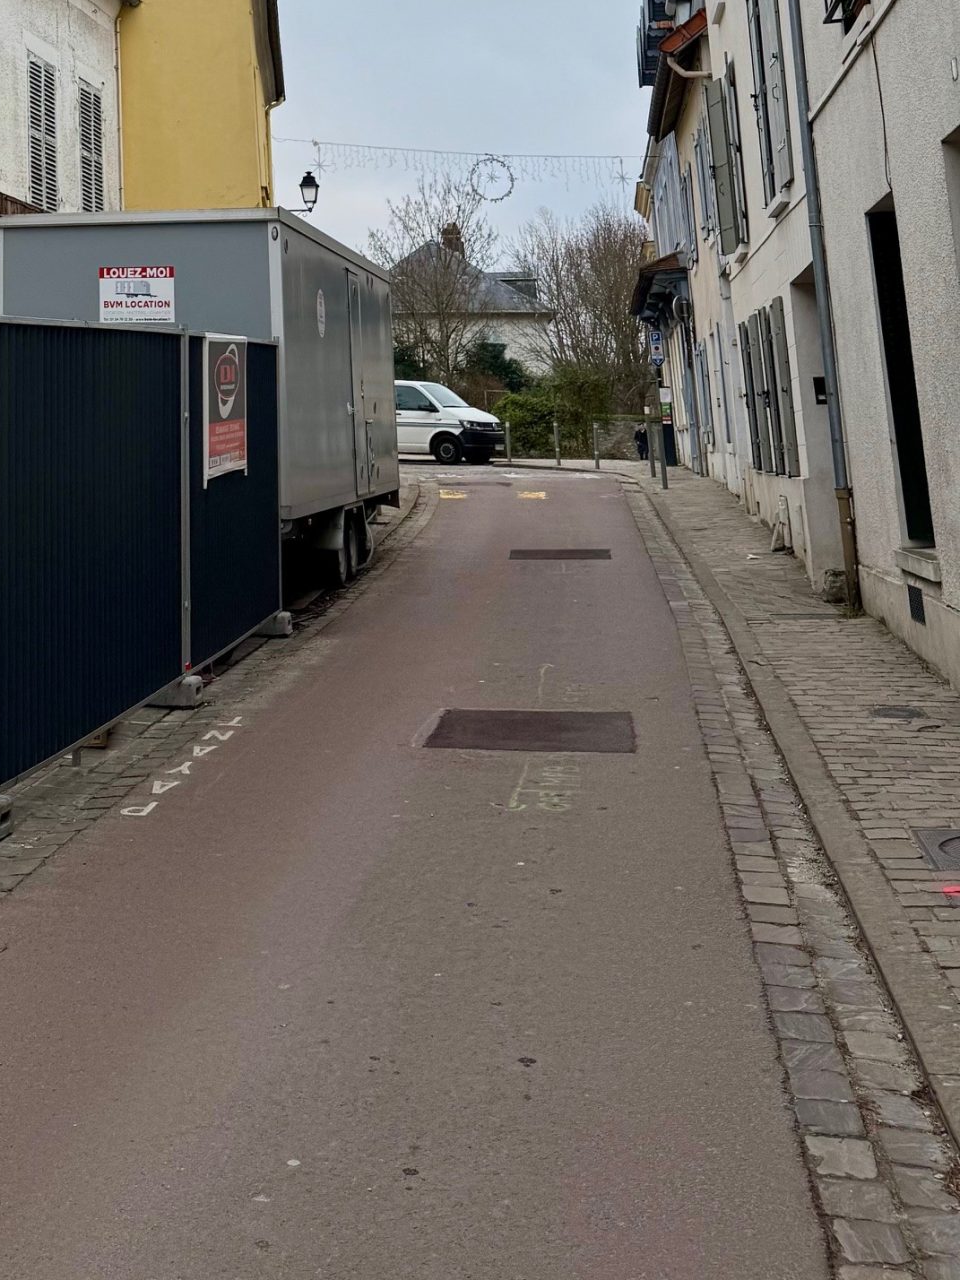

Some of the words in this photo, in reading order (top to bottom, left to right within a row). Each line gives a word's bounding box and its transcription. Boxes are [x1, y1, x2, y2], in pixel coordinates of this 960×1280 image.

[103, 267, 170, 278] LOUEZ-MOI
[103, 300, 123, 308] BVM
[125, 300, 171, 309] LOCATION
[220, 364, 236, 384] DI
